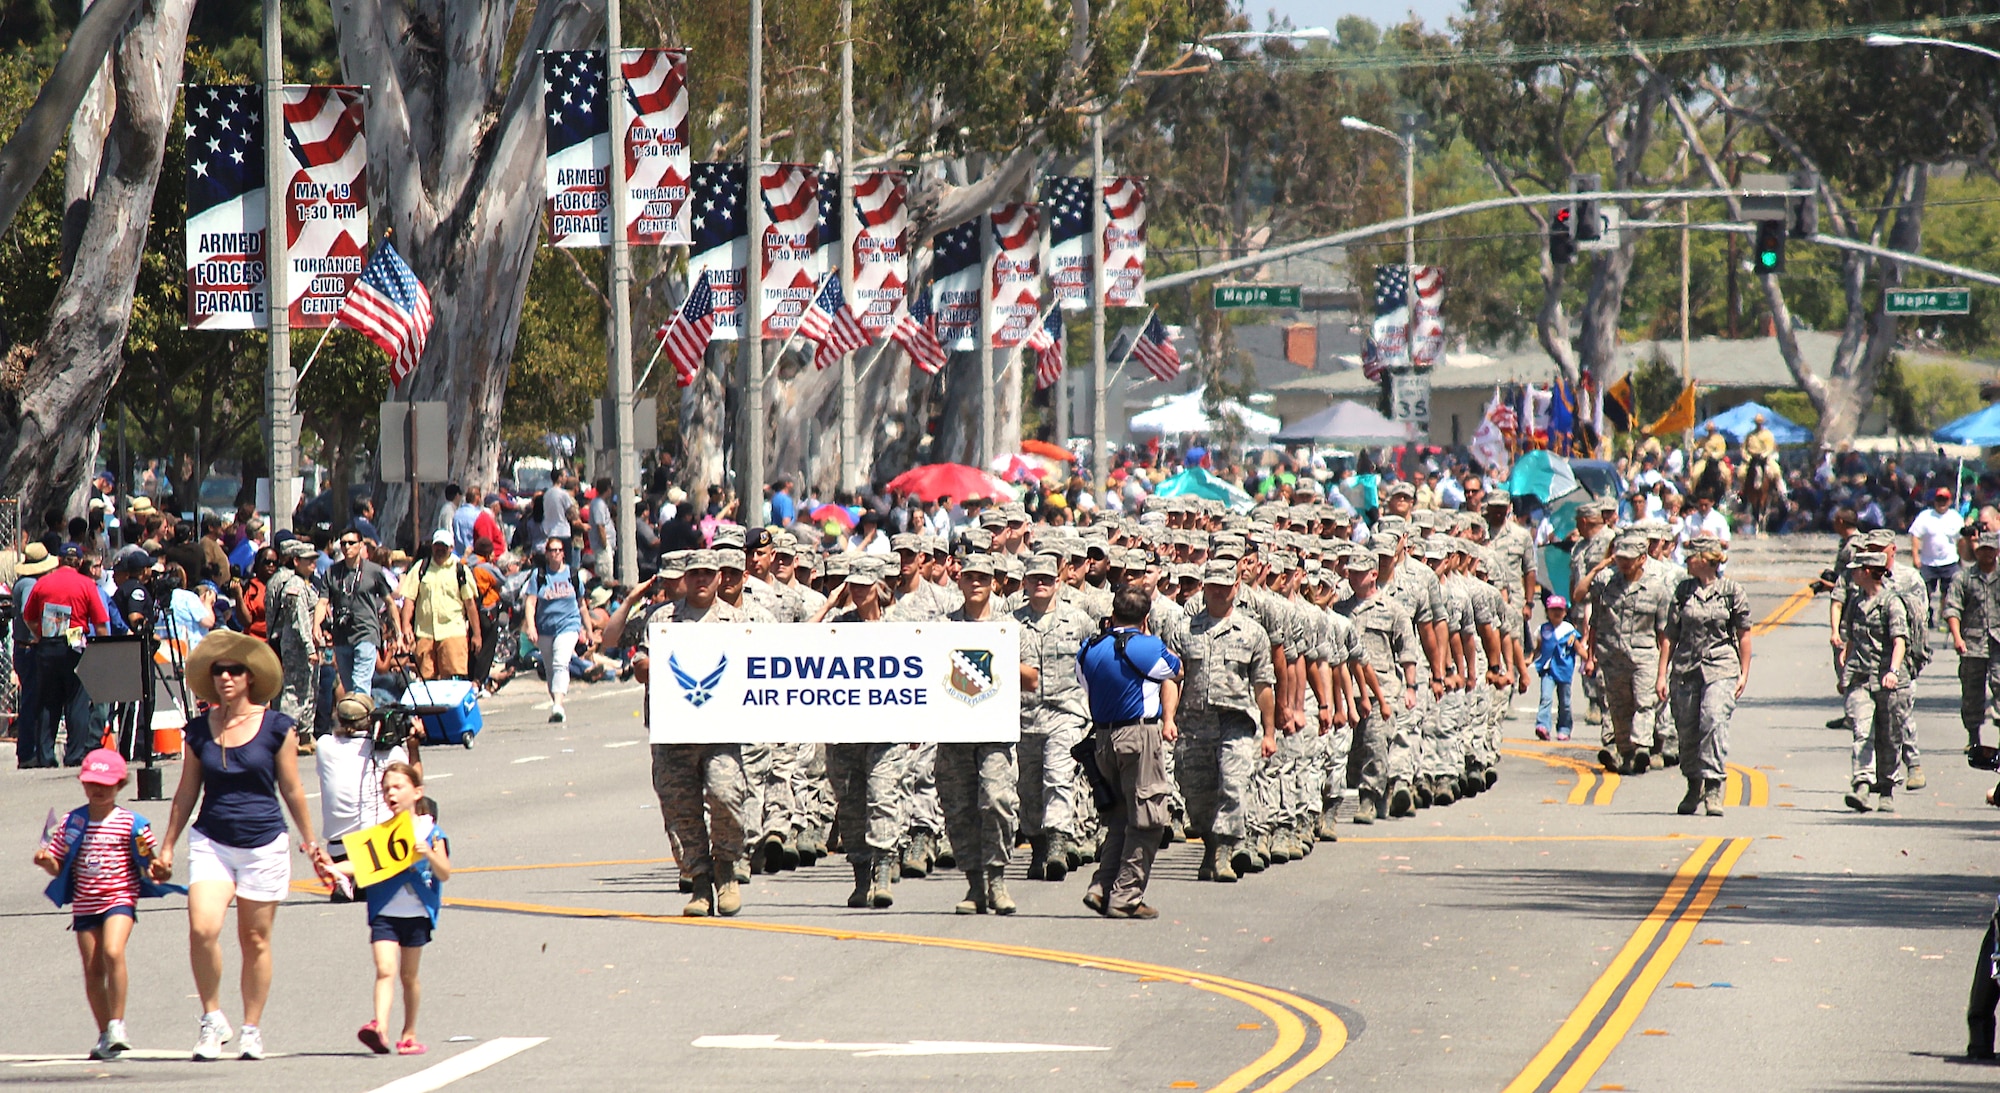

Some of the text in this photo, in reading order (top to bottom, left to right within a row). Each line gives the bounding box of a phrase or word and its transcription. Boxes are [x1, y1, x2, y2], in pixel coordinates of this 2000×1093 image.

[632, 127, 676, 140] MAY 19
[632, 144, 681, 157] 1:30 PM
[557, 168, 605, 185] ARMED
[296, 183, 349, 198] MAY 19
[631, 187, 685, 199] TORRANCE
[555, 192, 608, 210] FORCES
[297, 203, 356, 220] 1:30 PM
[644, 204, 671, 216] CIVIC
[555, 217, 608, 233] PARADE
[638, 220, 678, 233] CENTER
[198, 233, 260, 253] ARMED
[767, 234, 790, 246] MAY
[794, 249, 810, 260] PM
[293, 258, 361, 273] TORRANCE
[196, 263, 264, 284] FORCES
[705, 269, 742, 281] RMED
[310, 278, 344, 293] CIVIC
[196, 292, 264, 313] PARADE
[711, 290, 744, 305] RCES
[1224, 288, 1268, 304] Maple
[1893, 294, 1938, 308] Maple
[302, 298, 345, 313] CENTE
[1398, 400, 1427, 418] 35
[746, 656, 923, 679] EDWARDS
[742, 688, 927, 706] AIR FORCE BASE
[91, 762, 109, 772] gap
[362, 822, 409, 874] 16
